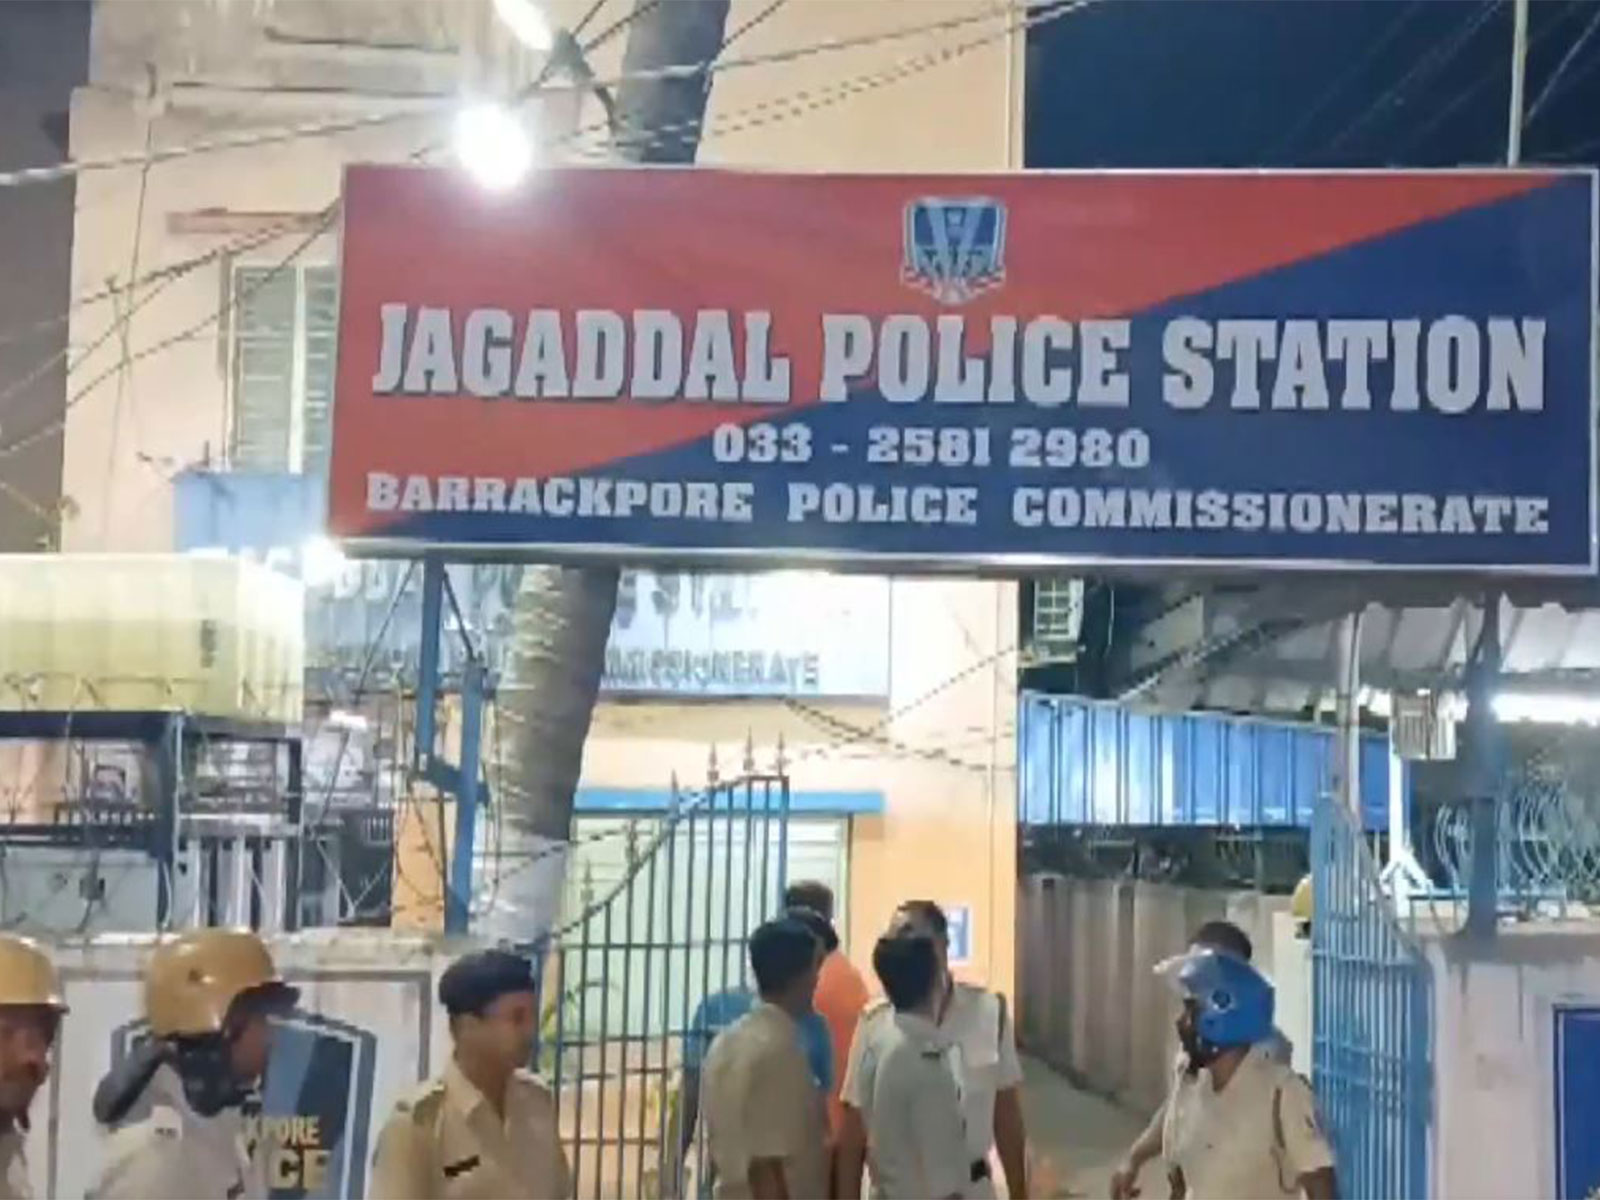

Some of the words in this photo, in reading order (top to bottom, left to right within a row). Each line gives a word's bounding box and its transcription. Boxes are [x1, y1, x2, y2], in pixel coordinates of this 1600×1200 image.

[371, 303, 791, 403] JAGADDAL
[820, 312, 1133, 404] POLICE
[1161, 315, 1548, 412] STATION
[712, 422, 812, 463] 033
[866, 425, 992, 466] 2581
[1008, 427, 1151, 468] 2980
[366, 471, 754, 521] BARRACKPORE
[787, 482, 978, 525] POLICE
[1012, 487, 1550, 534] COMMISSIONERATE
